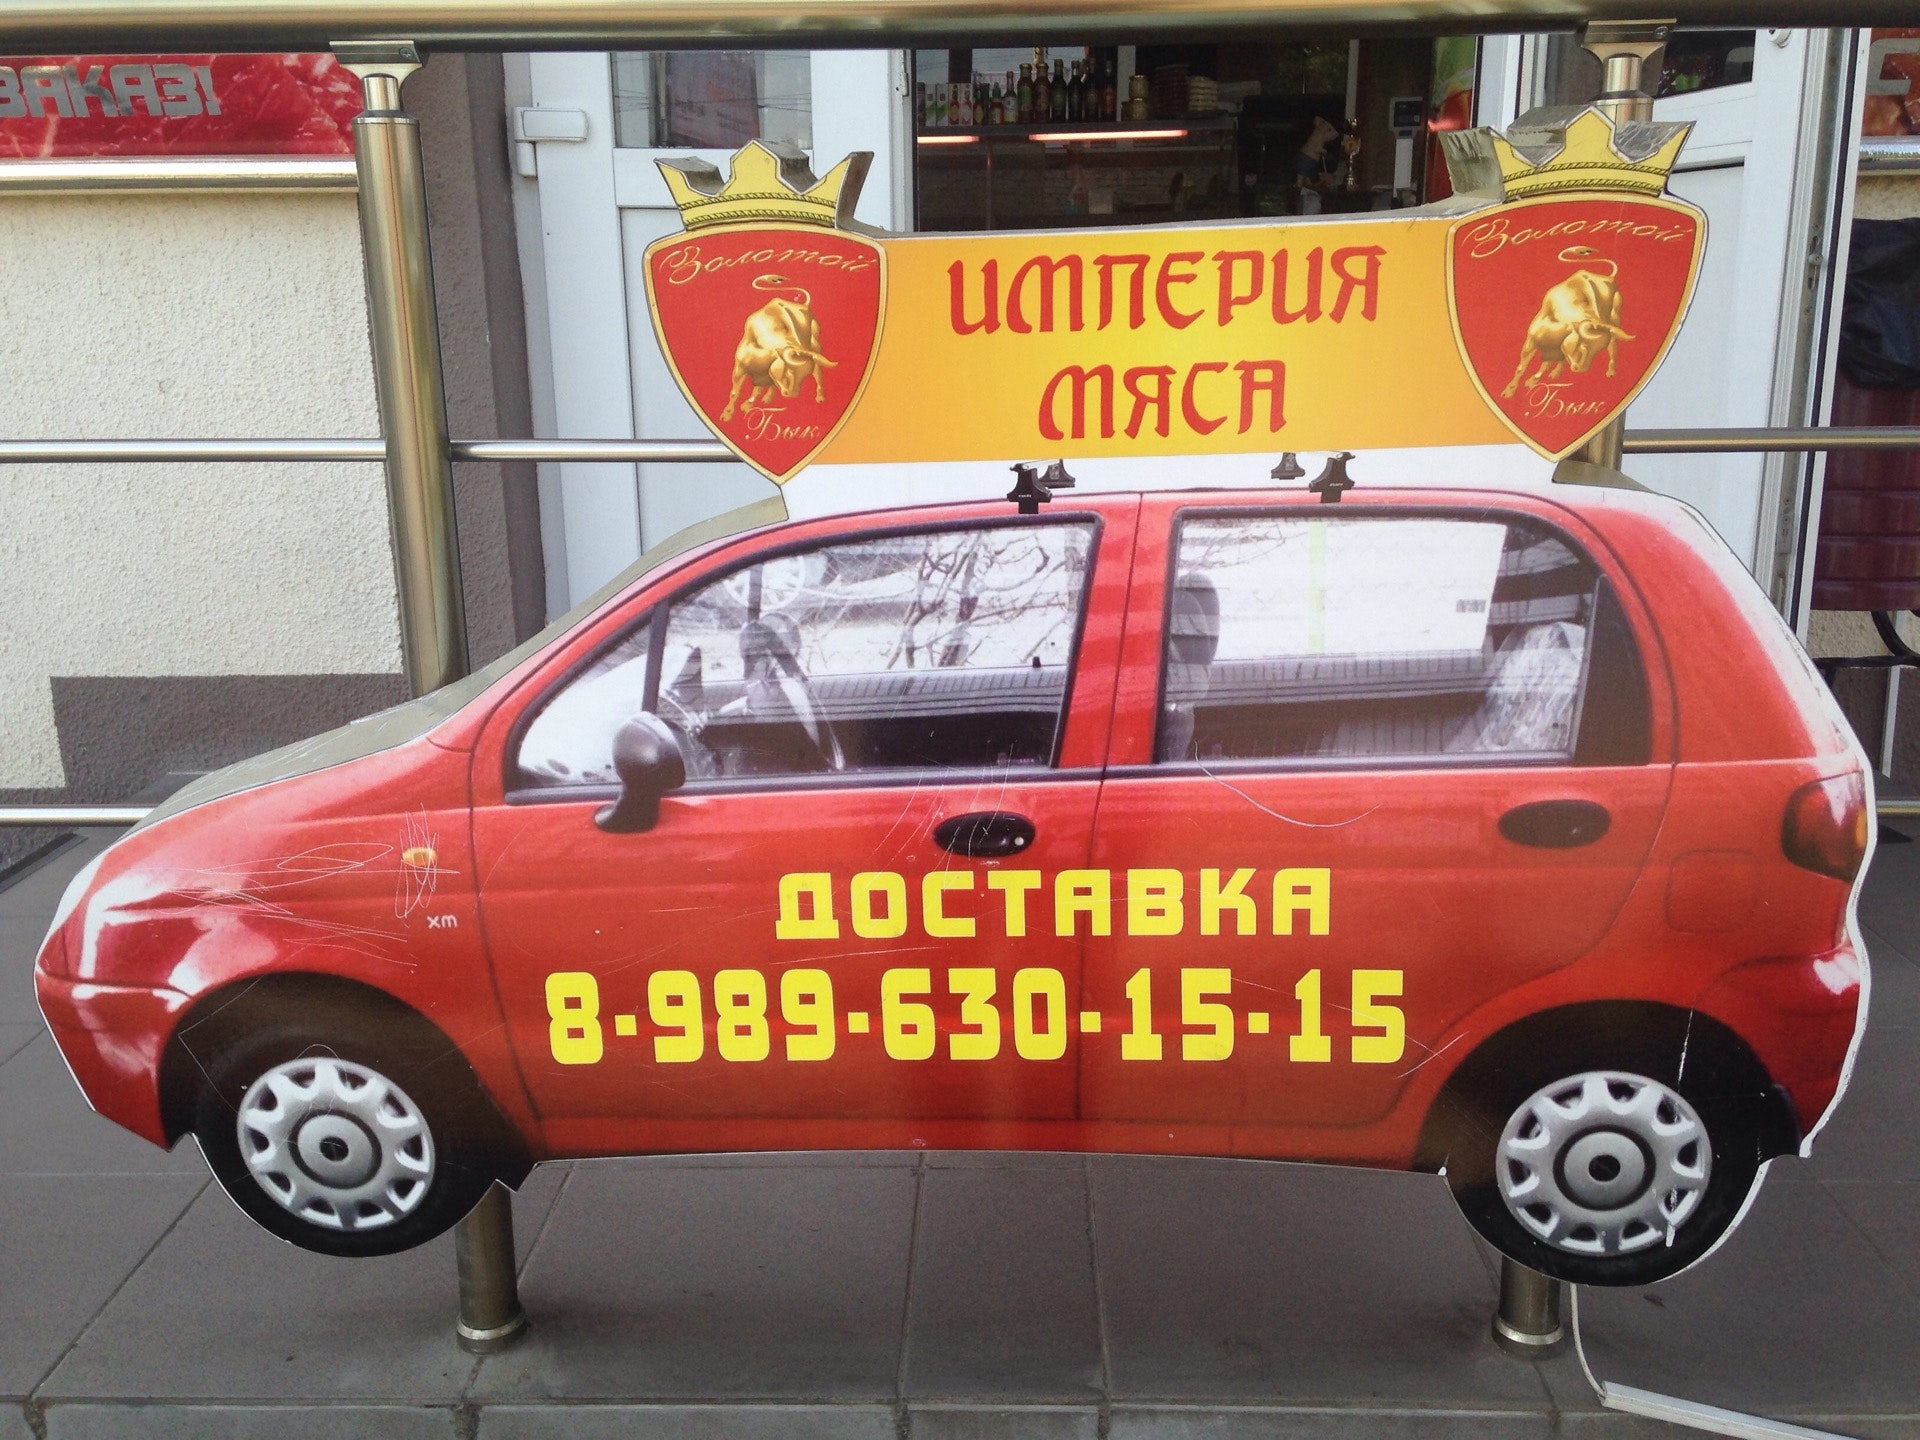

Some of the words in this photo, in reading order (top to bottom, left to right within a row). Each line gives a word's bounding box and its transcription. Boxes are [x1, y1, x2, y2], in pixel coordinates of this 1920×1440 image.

[1461, 218, 1692, 259] Золотой
[659, 246, 877, 285] Золотой
[947, 245, 1387, 336] ИМПЕРИЯ
[1038, 360, 1287, 441] МЯСА
[1524, 382, 1605, 418] Бык
[744, 406, 821, 442] Бык
[426, 914, 458, 929] xm
[775, 869, 1330, 940] ДОСТАВКА
[545, 967, 1406, 1066] 8-989-630-15-15
